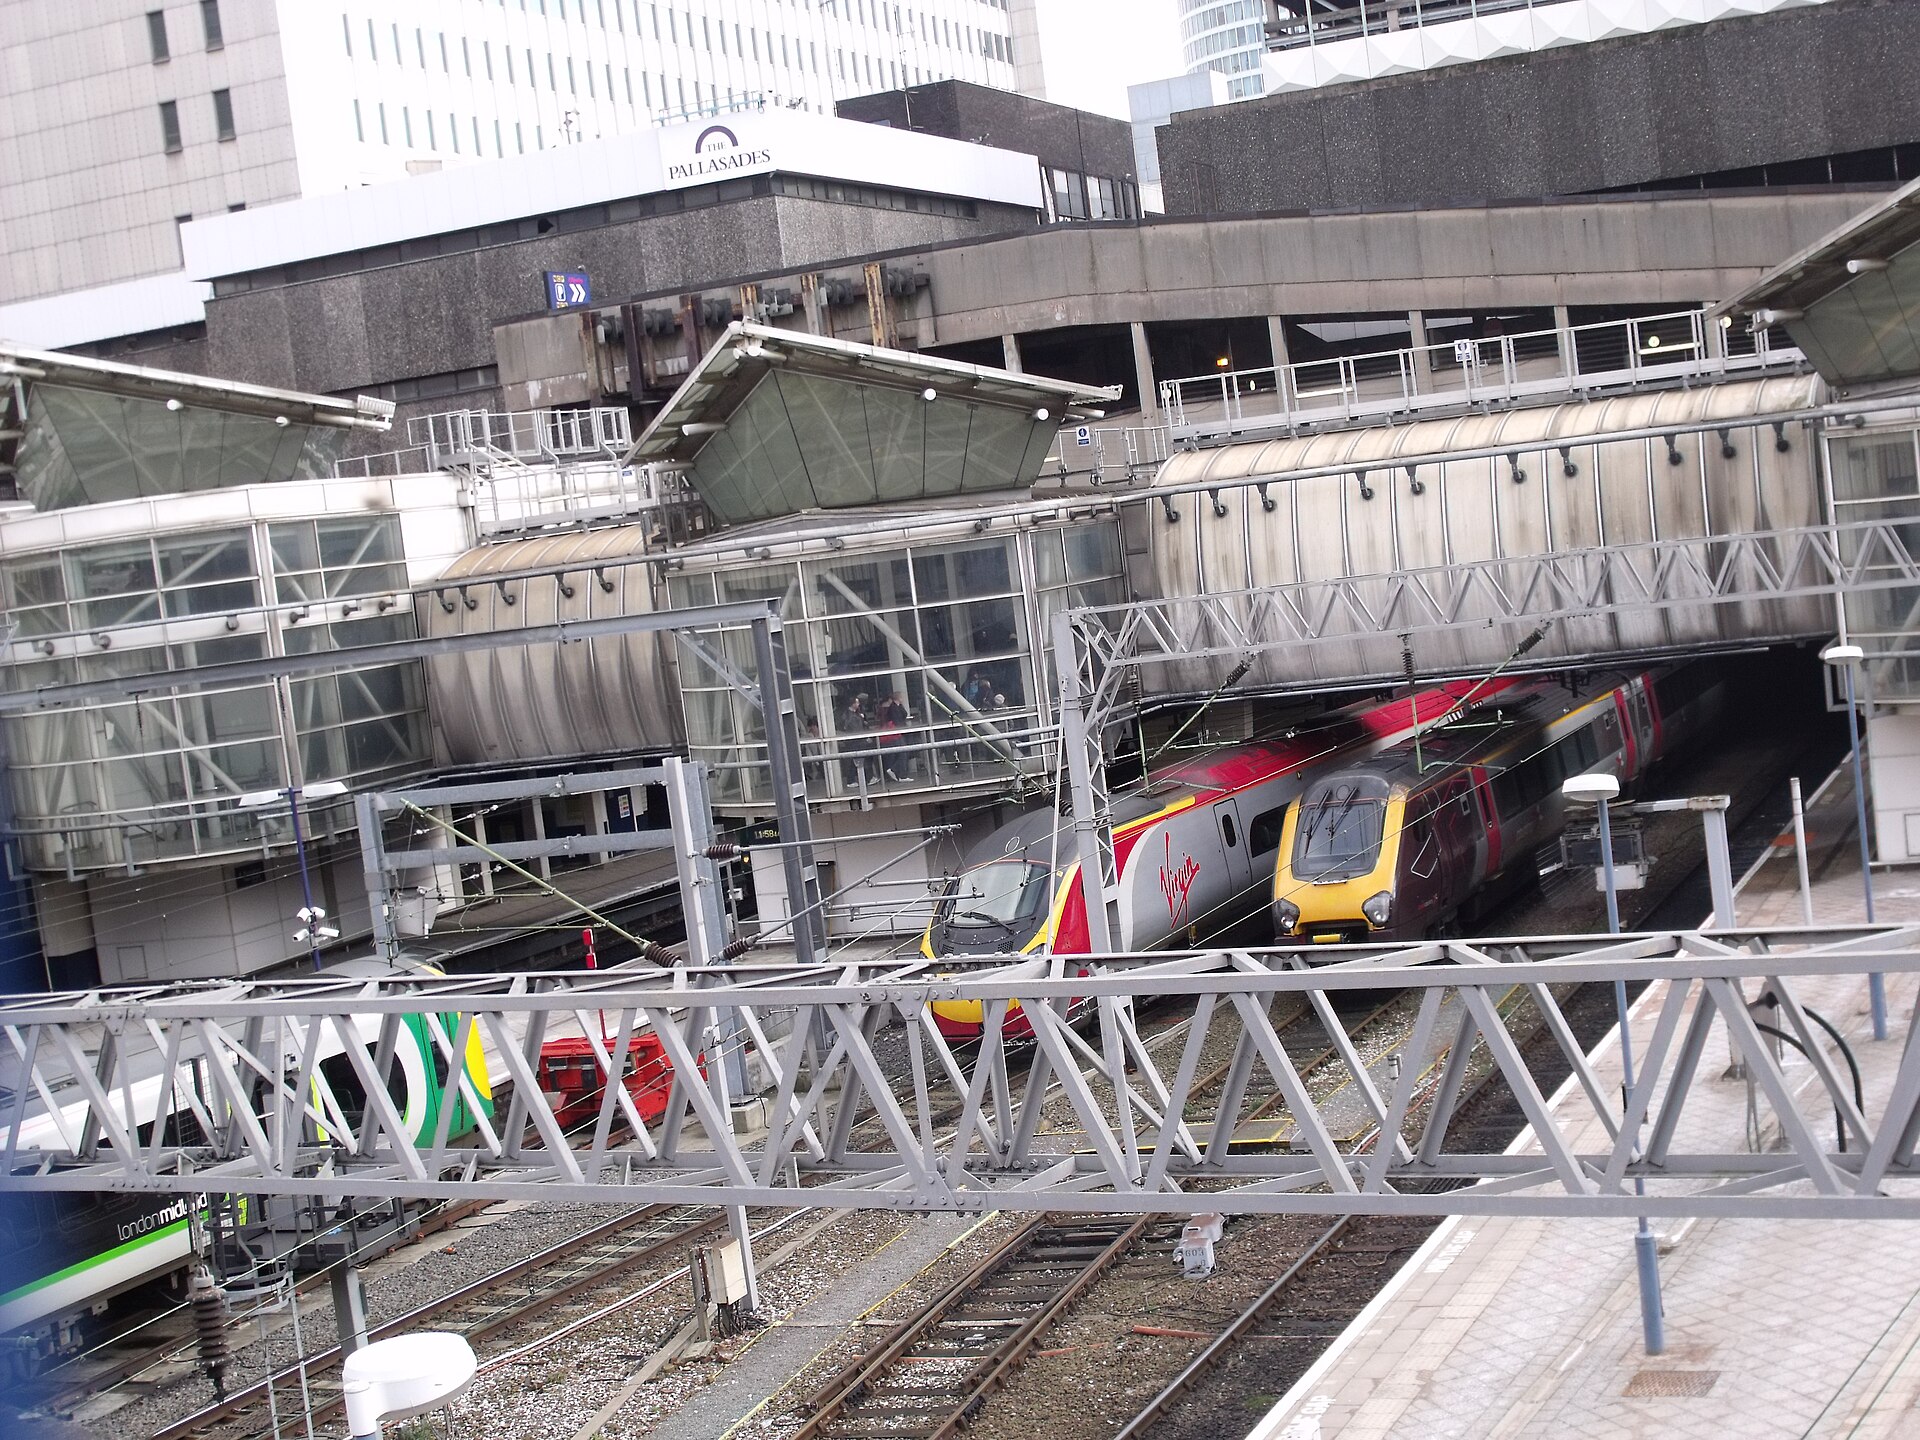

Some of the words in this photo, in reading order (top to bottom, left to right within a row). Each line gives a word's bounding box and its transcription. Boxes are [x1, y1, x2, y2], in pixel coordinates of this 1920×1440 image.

[705, 141, 727, 152] THE
[668, 148, 771, 180] PALLASADES
[1159, 831, 1201, 930] Virgin
